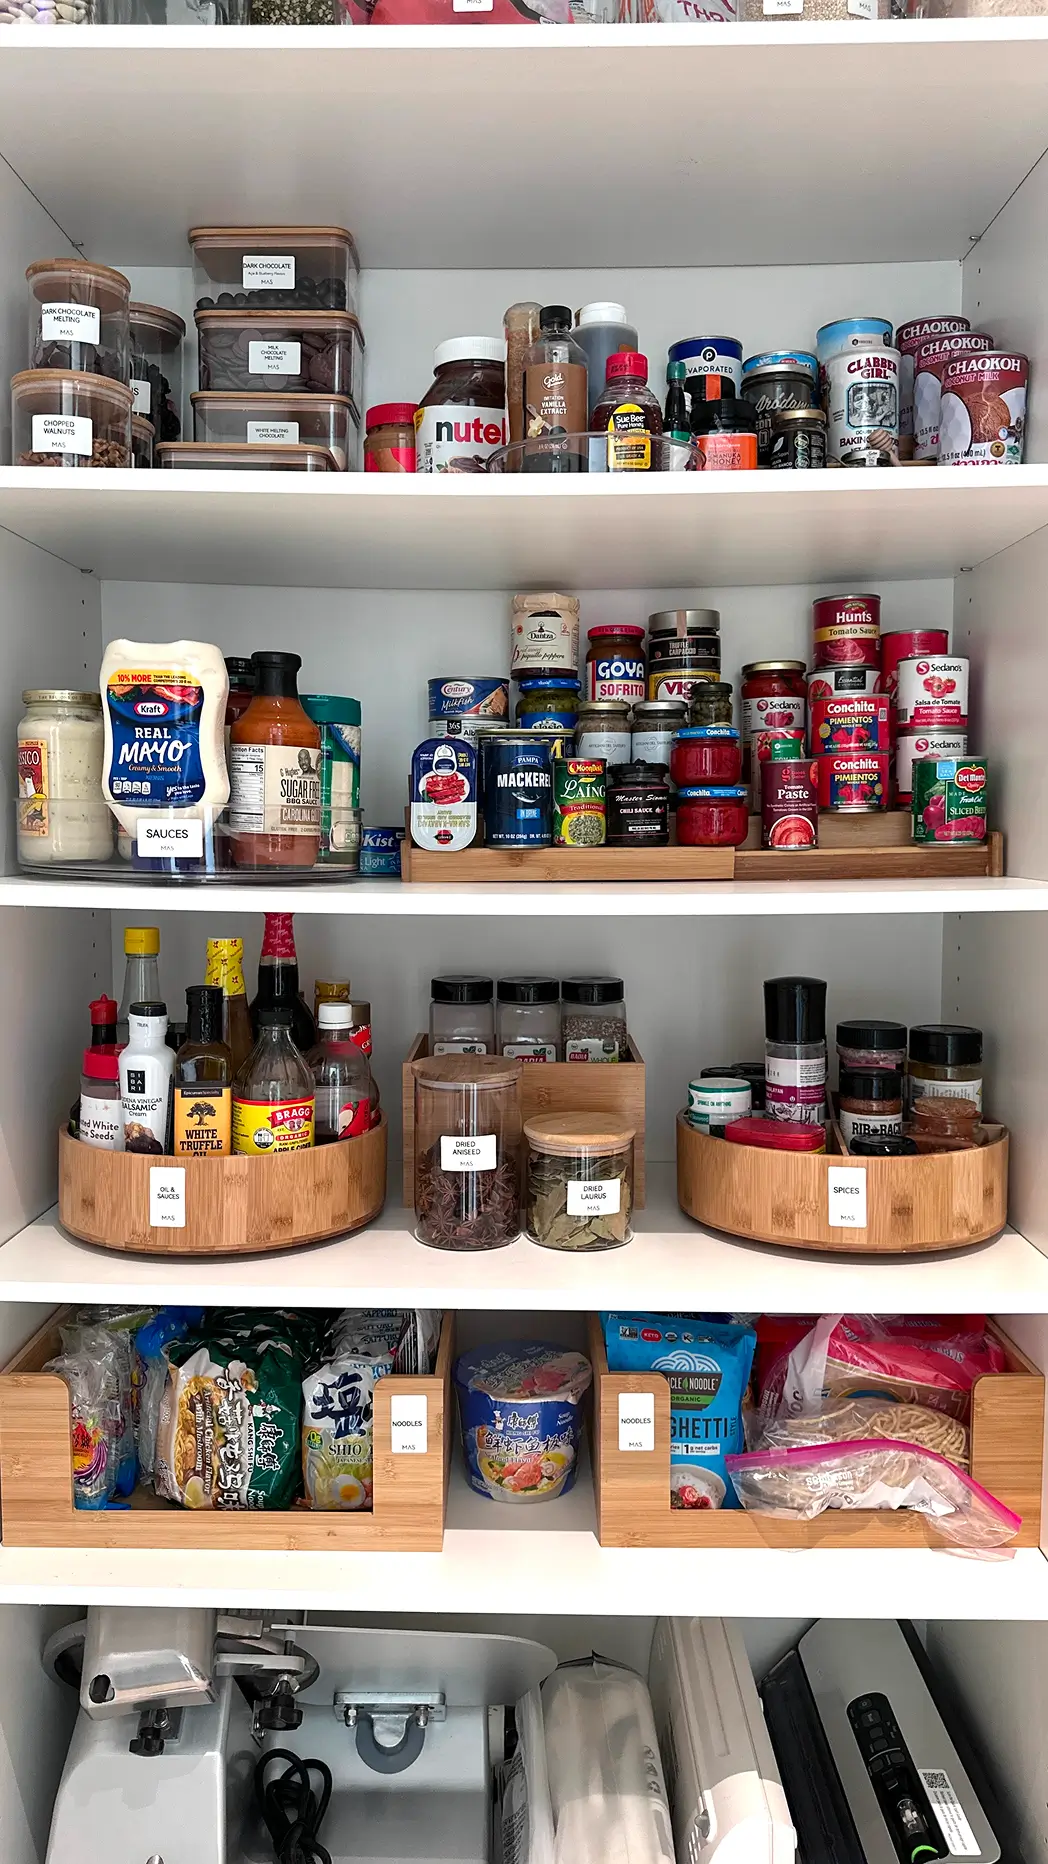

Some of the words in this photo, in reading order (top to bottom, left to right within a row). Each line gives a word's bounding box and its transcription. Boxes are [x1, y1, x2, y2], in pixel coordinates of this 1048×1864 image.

[858, 2, 872, 12] MAS
[42, 308, 57, 316] DARK
[58, 308, 96, 319] CHOCOLATE
[53, 316, 80, 324] MELTING
[902, 321, 966, 340] CHAOKOH
[920, 337, 990, 357] CHAOKOH
[847, 357, 898, 376] CLABBER
[948, 358, 1021, 376] CHAOKOH
[544, 372, 563, 388] Gold
[861, 370, 889, 380] GIRL
[978, 372, 1000, 381] MILK
[44, 420, 75, 428] CHOPPED
[616, 416, 630, 424] Sue
[630, 414, 646, 422] Bee
[43, 428, 76, 436] WALNUTS
[436, 416, 506, 446] nutel
[530, 632, 554, 640] Dantza
[828, 628, 858, 636] Tomato
[542, 652, 565, 660] peppers
[668, 648, 696, 656] CARPACCIO
[598, 661, 644, 679] GOYA
[131, 674, 152, 682] MORE
[444, 684, 472, 695] Century
[600, 683, 644, 697] SOFRITO
[140, 704, 161, 714] Kraft
[440, 696, 475, 712] Milkfish
[827, 700, 876, 714] Conchita
[829, 716, 874, 724] PIMIENTOS
[448, 722, 461, 730] 365
[134, 727, 172, 739] REAL
[706, 728, 731, 736] Conchita
[118, 740, 193, 765] MAYO
[128, 764, 150, 774] Creamy
[151, 764, 156, 772] &
[156, 764, 182, 772] Smooth
[254, 764, 264, 772] 15
[834, 760, 880, 771] Conchita
[834, 774, 878, 782] PIMIENTOS
[958, 774, 970, 782] Del
[166, 786, 177, 797] yes
[280, 778, 308, 798] SUGAR
[560, 780, 606, 800] LAÍNG
[616, 794, 643, 802] Master
[777, 789, 810, 800] Paste
[570, 804, 604, 812] Traditional
[950, 806, 974, 815] SLICED
[282, 808, 310, 822] CAROLINA
[526, 810, 538, 818] BRINE
[146, 829, 189, 839] SAUCES
[360, 833, 394, 848] Kist
[364, 857, 386, 868] Light
[275, 1107, 310, 1120] BRAGG
[92, 1120, 120, 1131] White
[852, 1122, 871, 1134] RIB
[90, 1130, 115, 1140] Seeds
[184, 1128, 218, 1140] WHITE
[280, 1131, 309, 1140] ORGANIC
[180, 1140, 223, 1151] TRUFFLE
[455, 1140, 476, 1148] DRIED
[452, 1148, 481, 1156] ANISEED
[833, 1186, 860, 1195] SPICES
[580, 1192, 607, 1200] LAURUS
[362, 1310, 398, 1318] SAPPORO
[364, 1334, 400, 1344] SAPPORO
[689, 1376, 716, 1391] NOODLE
[195, 1403, 204, 1422] With
[670, 1417, 728, 1439] GHETTI
[730, 1416, 738, 1436] STYLE
[195, 1422, 204, 1472] Mushroom
[204, 1427, 214, 1464] Chicken
[328, 1444, 362, 1456] SHIO
[684, 1444, 689, 1454] 1
[248, 1463, 254, 1473] FU
[204, 1464, 213, 1494] Flavor
